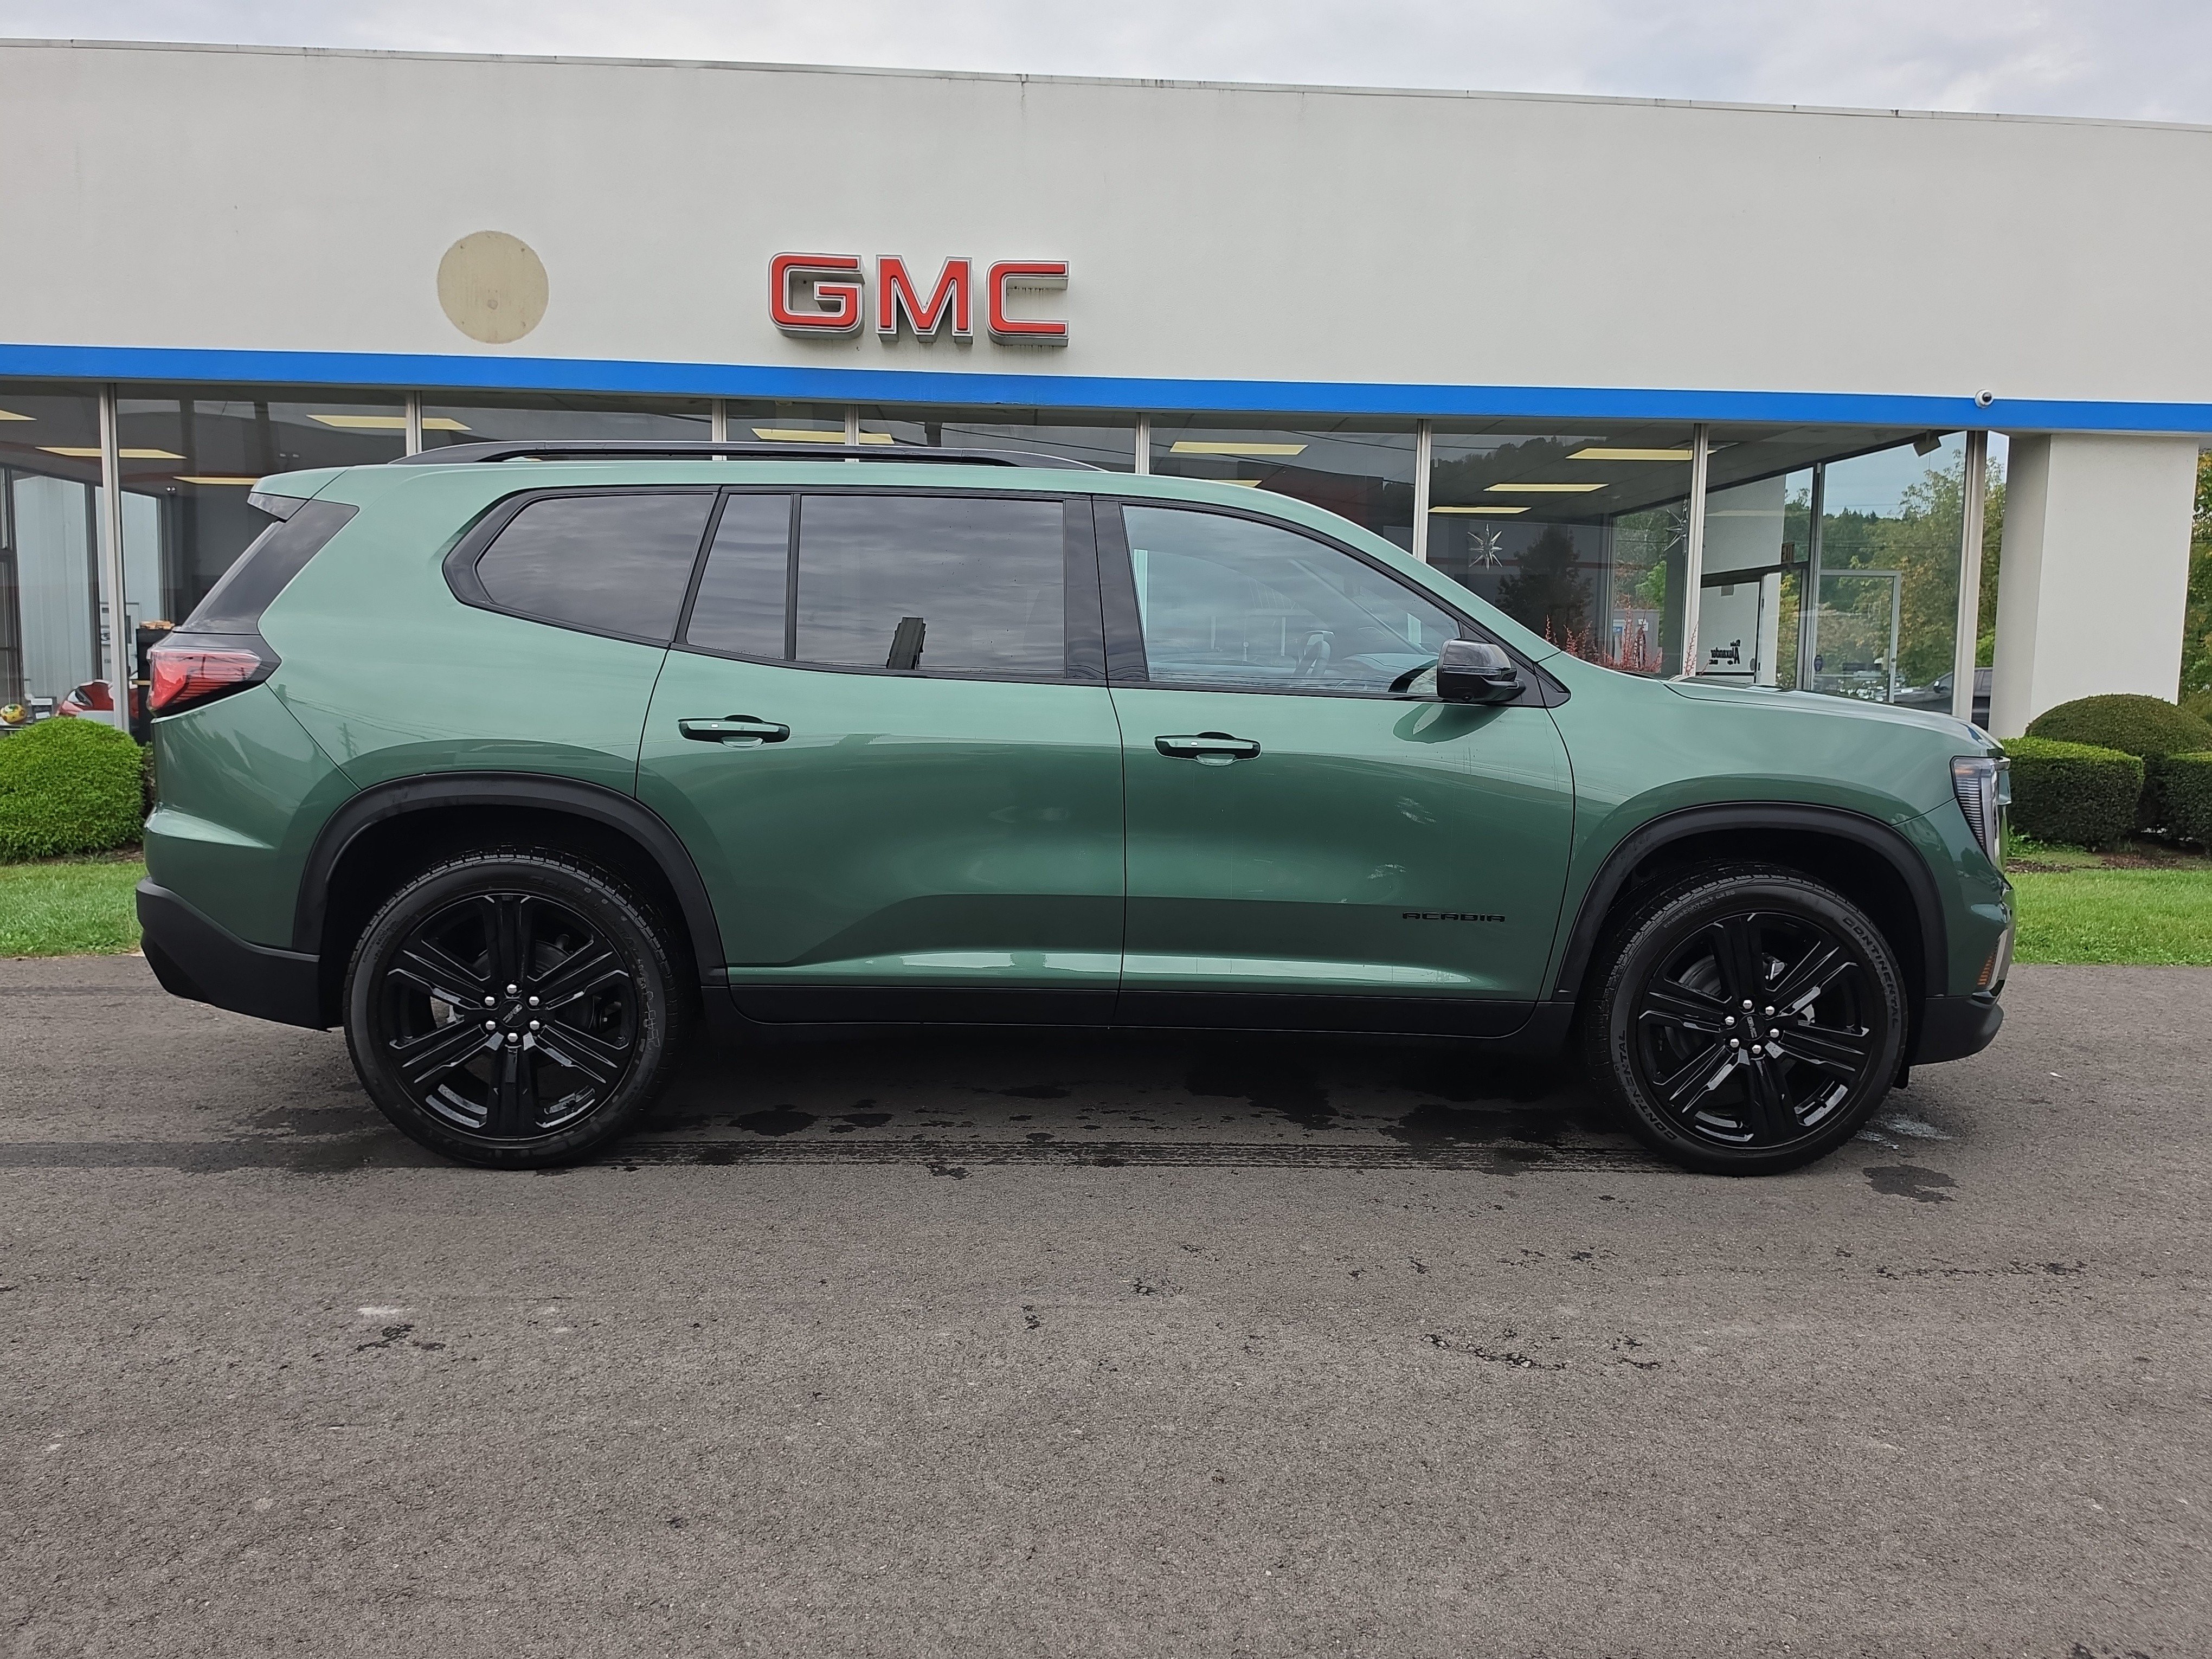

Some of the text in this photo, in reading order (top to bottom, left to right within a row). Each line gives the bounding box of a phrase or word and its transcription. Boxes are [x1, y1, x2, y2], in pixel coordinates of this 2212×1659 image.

[768, 252, 1070, 343] GMC
[1402, 911, 1506, 922] ACADIA
[1842, 917, 1899, 1029] CONTINENTAL
[1618, 1029, 1678, 1141] CONTINENTAL
